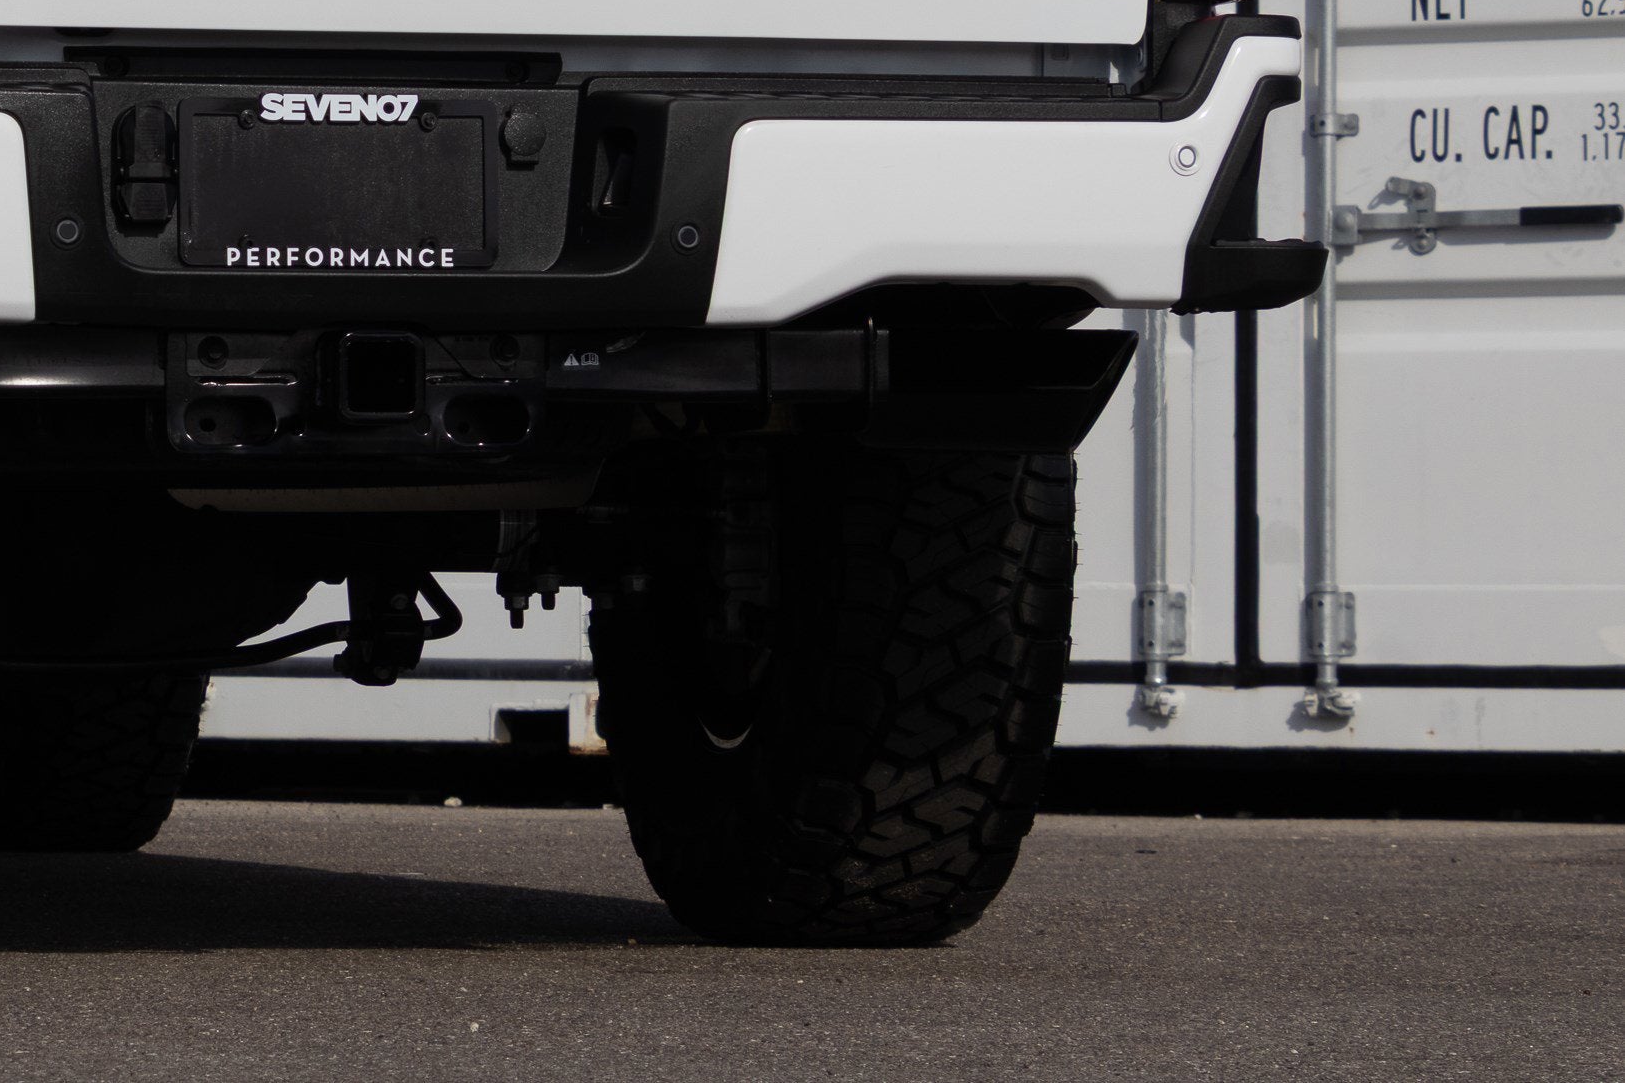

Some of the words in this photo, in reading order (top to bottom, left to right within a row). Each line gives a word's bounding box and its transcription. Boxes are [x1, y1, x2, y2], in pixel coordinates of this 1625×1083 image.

[1409, 108, 1462, 163] CU.
[1483, 104, 1553, 160] CAP.
[226, 246, 455, 268] PERFORMANCE
